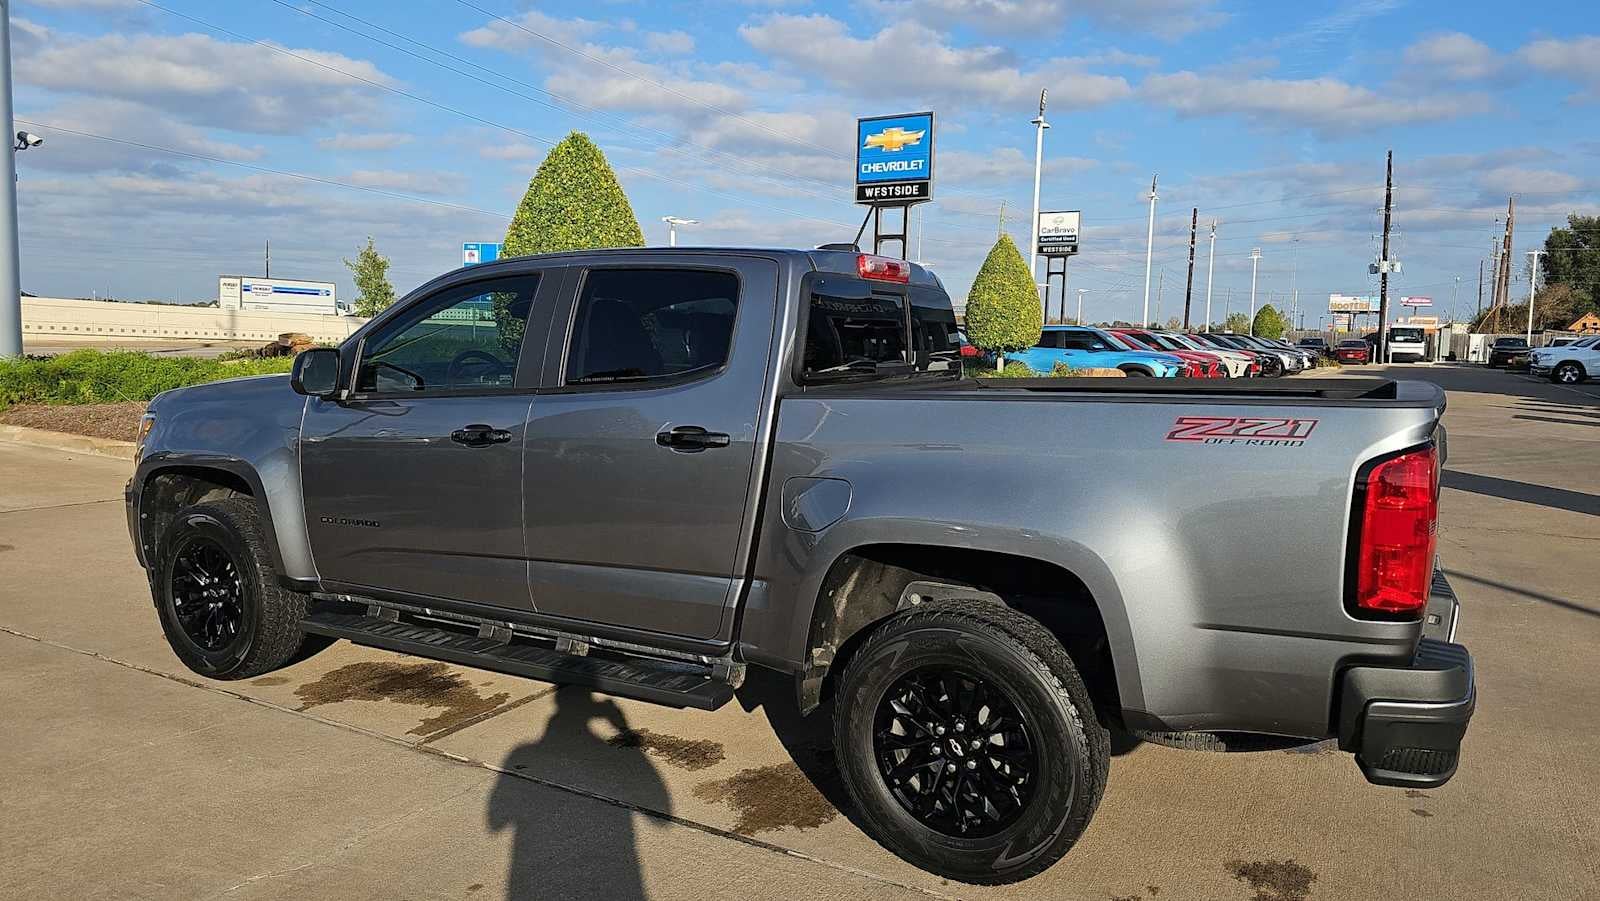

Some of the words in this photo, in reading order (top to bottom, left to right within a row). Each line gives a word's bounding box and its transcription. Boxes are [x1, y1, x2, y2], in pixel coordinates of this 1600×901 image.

[861, 159, 924, 173] CHEVROLET
[865, 184, 919, 197] WESTSIDE
[1041, 226, 1075, 234] CarBravo
[1165, 416, 1319, 442] Z71
[1245, 439, 1304, 447] ROAD
[320, 517, 380, 527] COLORADO
